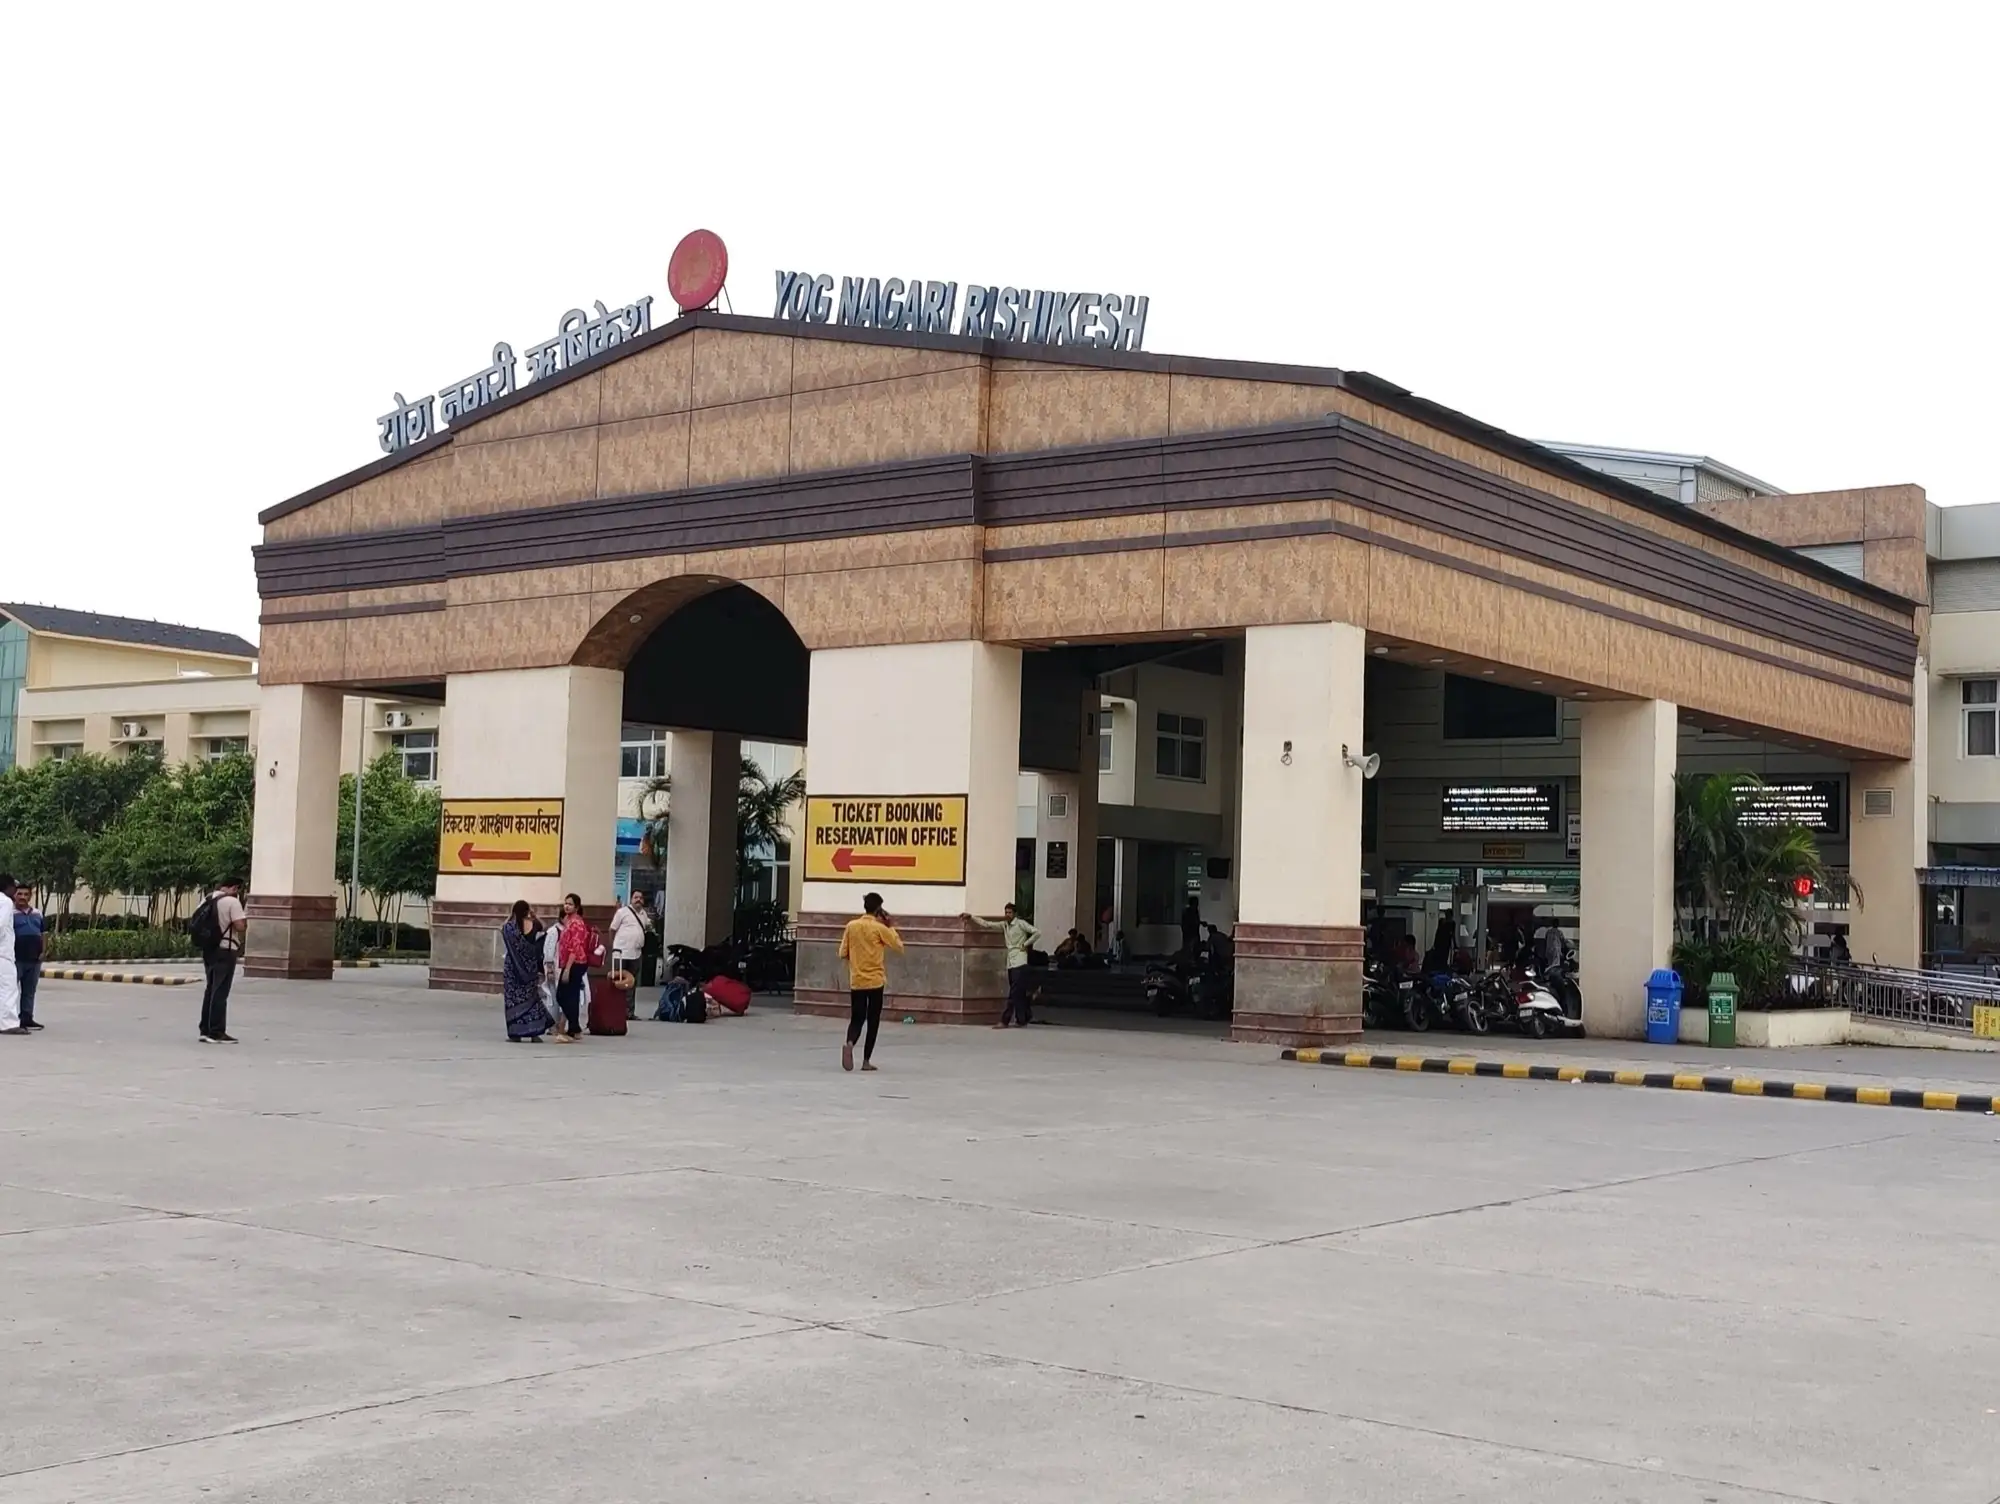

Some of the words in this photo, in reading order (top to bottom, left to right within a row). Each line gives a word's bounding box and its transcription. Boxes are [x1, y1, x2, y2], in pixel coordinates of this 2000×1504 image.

[774, 270, 834, 325] YOG
[836, 276, 958, 336] NAGARI
[960, 284, 1150, 351] RISHIKESH
[376, 392, 436, 453] योग
[439, 341, 517, 424] नगरी
[524, 295, 654, 385] ऋषिकेश
[515, 808, 561, 835] कार्यालय
[832, 803, 882, 823] TICKET
[886, 802, 943, 822] BOOKING
[816, 826, 908, 846] RESERVATION
[911, 827, 958, 846] OFFICE
